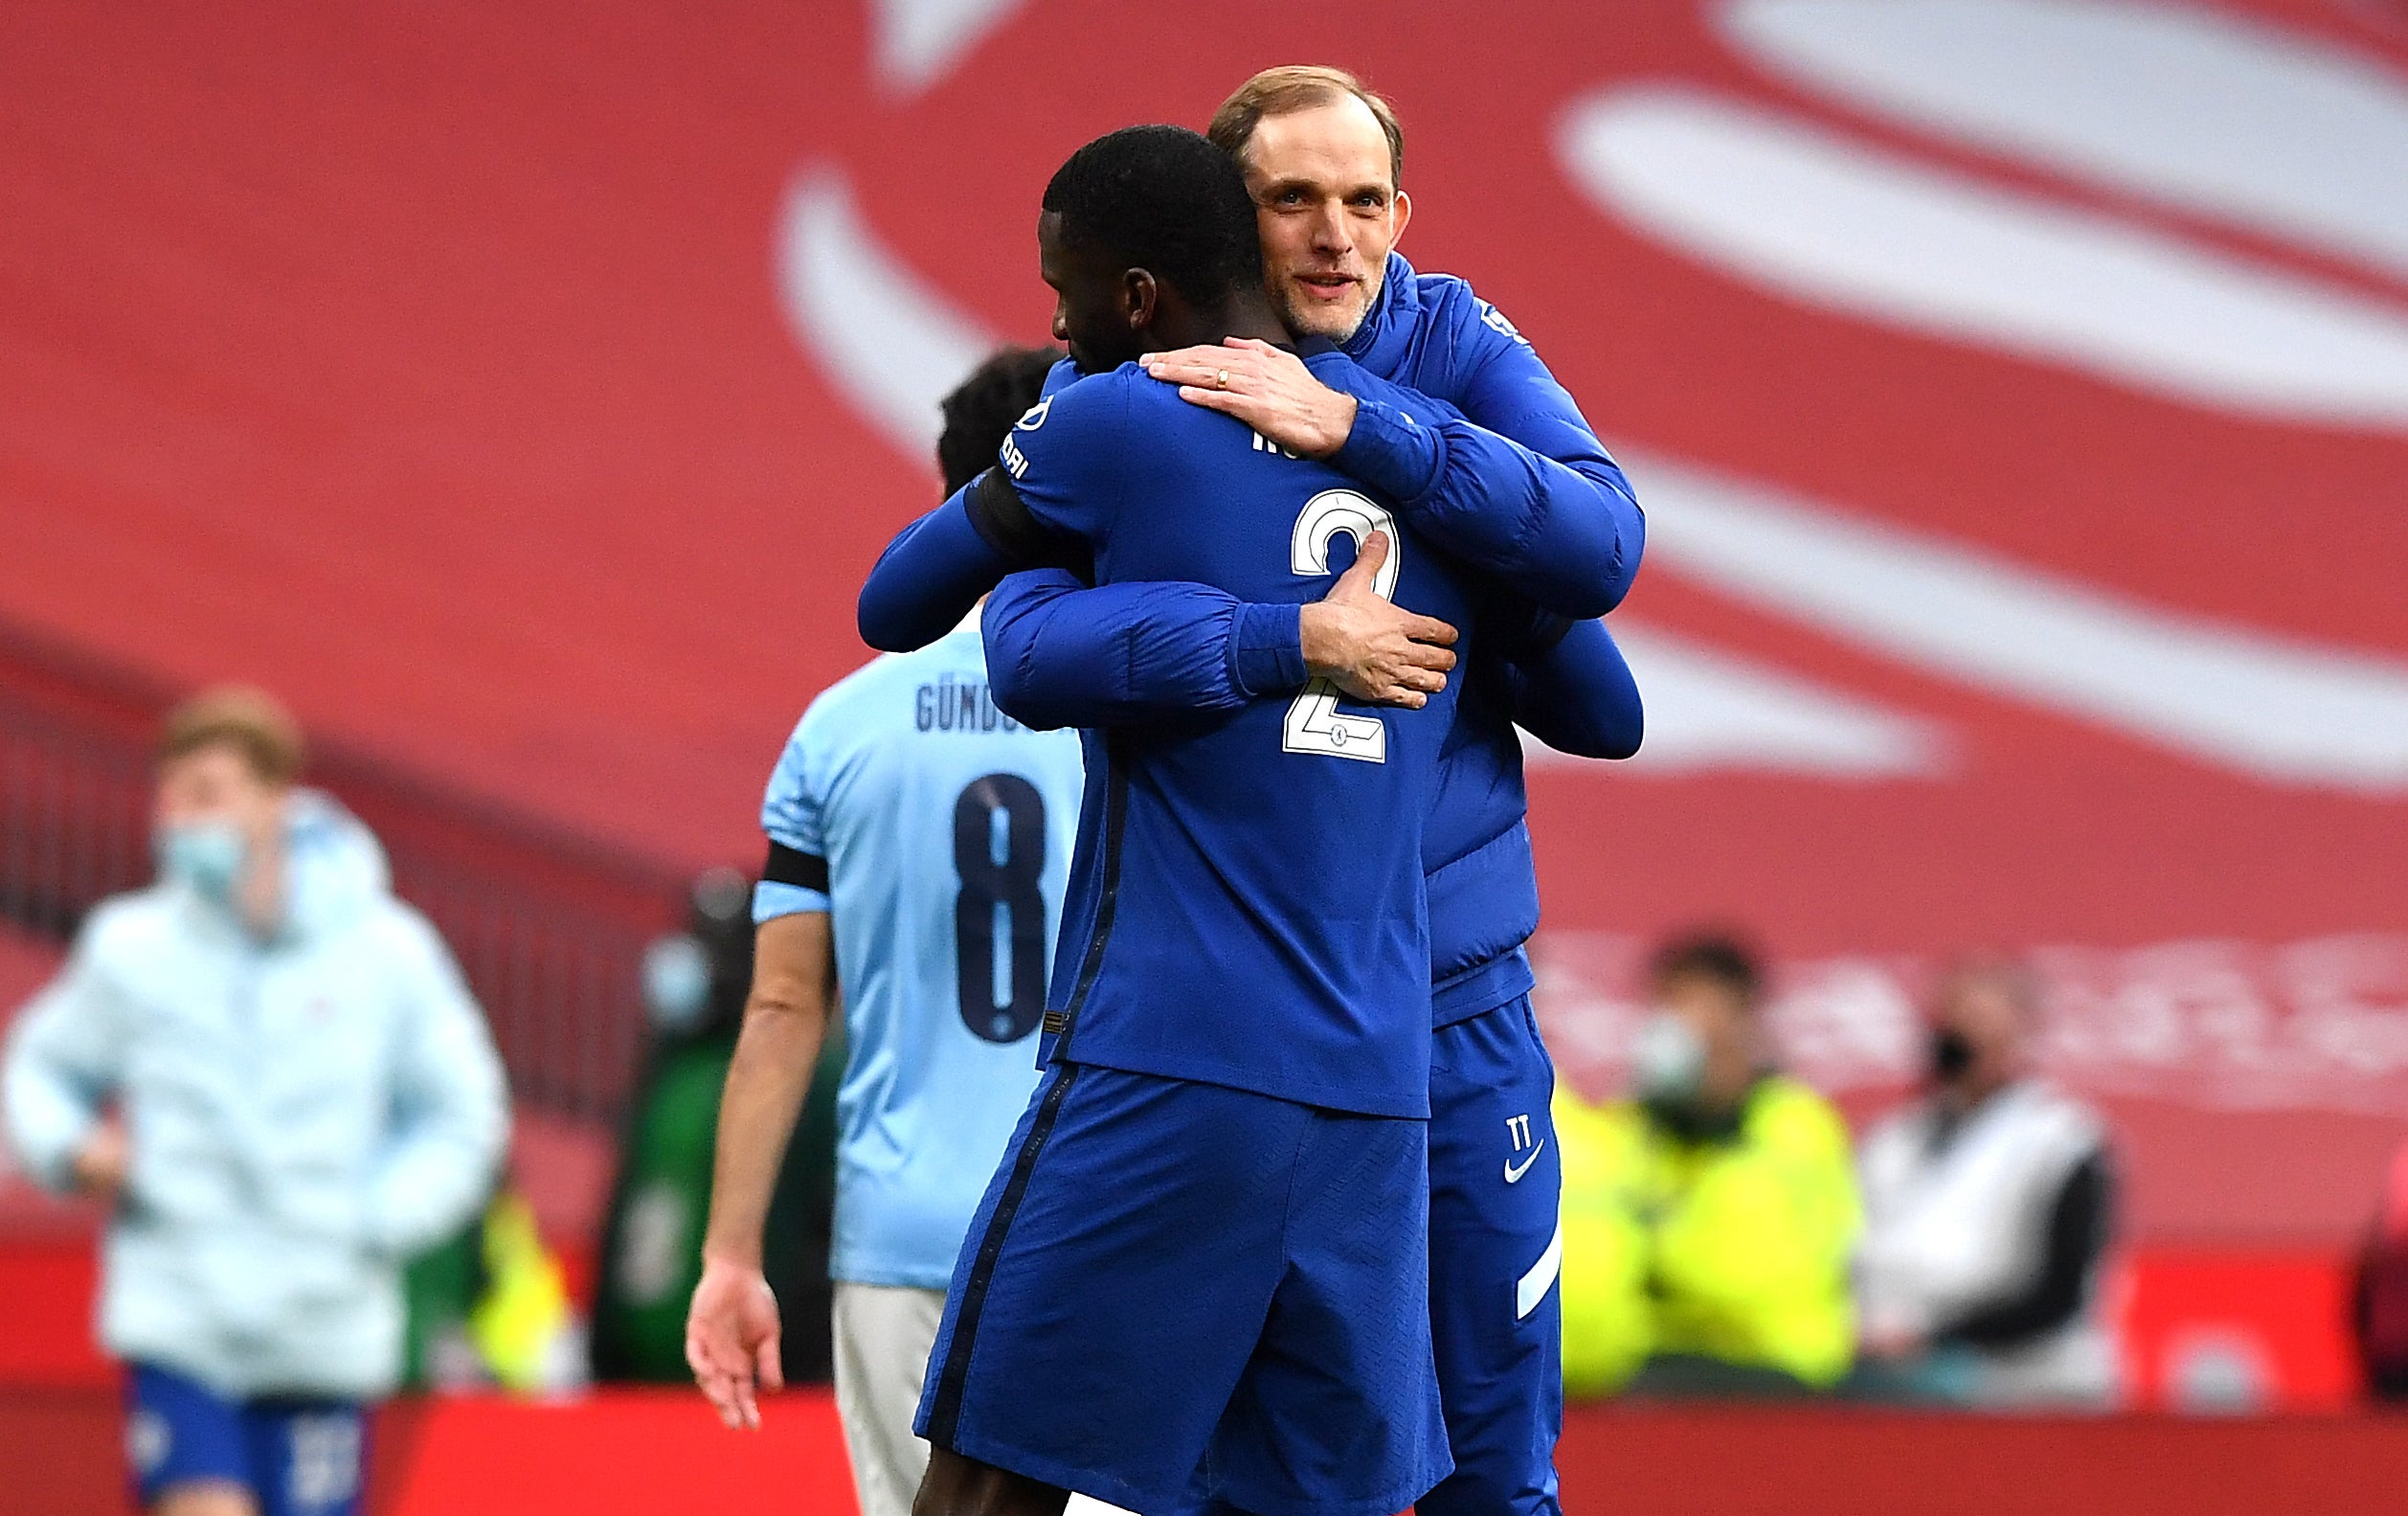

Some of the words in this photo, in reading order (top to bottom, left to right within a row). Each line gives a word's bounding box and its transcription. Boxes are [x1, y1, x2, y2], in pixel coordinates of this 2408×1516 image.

[916, 672, 1021, 733] GÜND
[1282, 488, 1401, 764] 2
[955, 772, 1046, 1044] 8
[1506, 1114, 1532, 1151] TT
